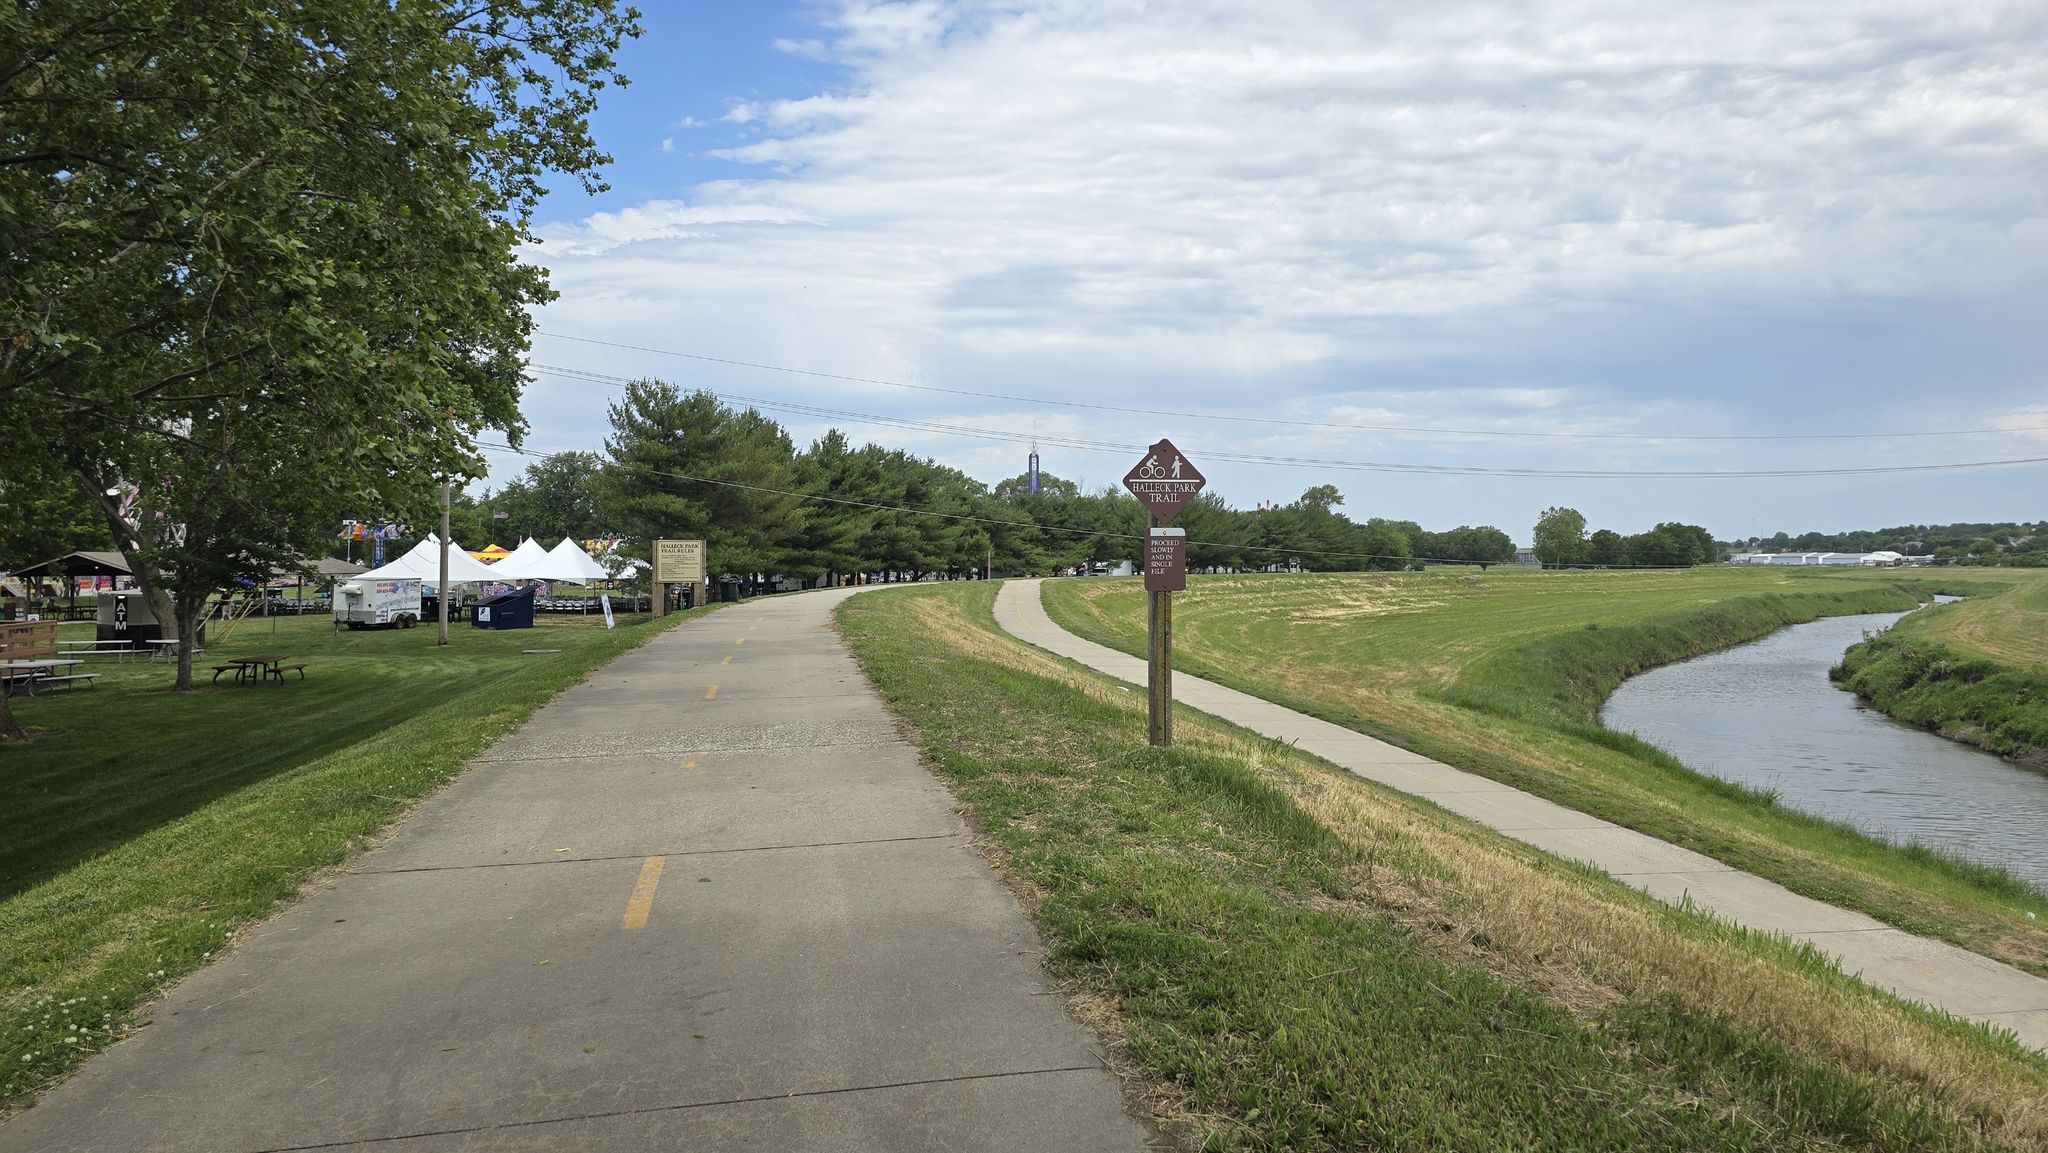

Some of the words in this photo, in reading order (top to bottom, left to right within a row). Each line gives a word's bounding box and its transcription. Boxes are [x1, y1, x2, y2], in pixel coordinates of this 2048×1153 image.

[1133, 483, 1172, 492] HALLECK
[1174, 483, 1196, 492] PARK
[1150, 494, 1180, 502] TRAIL
[115, 602, 127, 630] ATM
